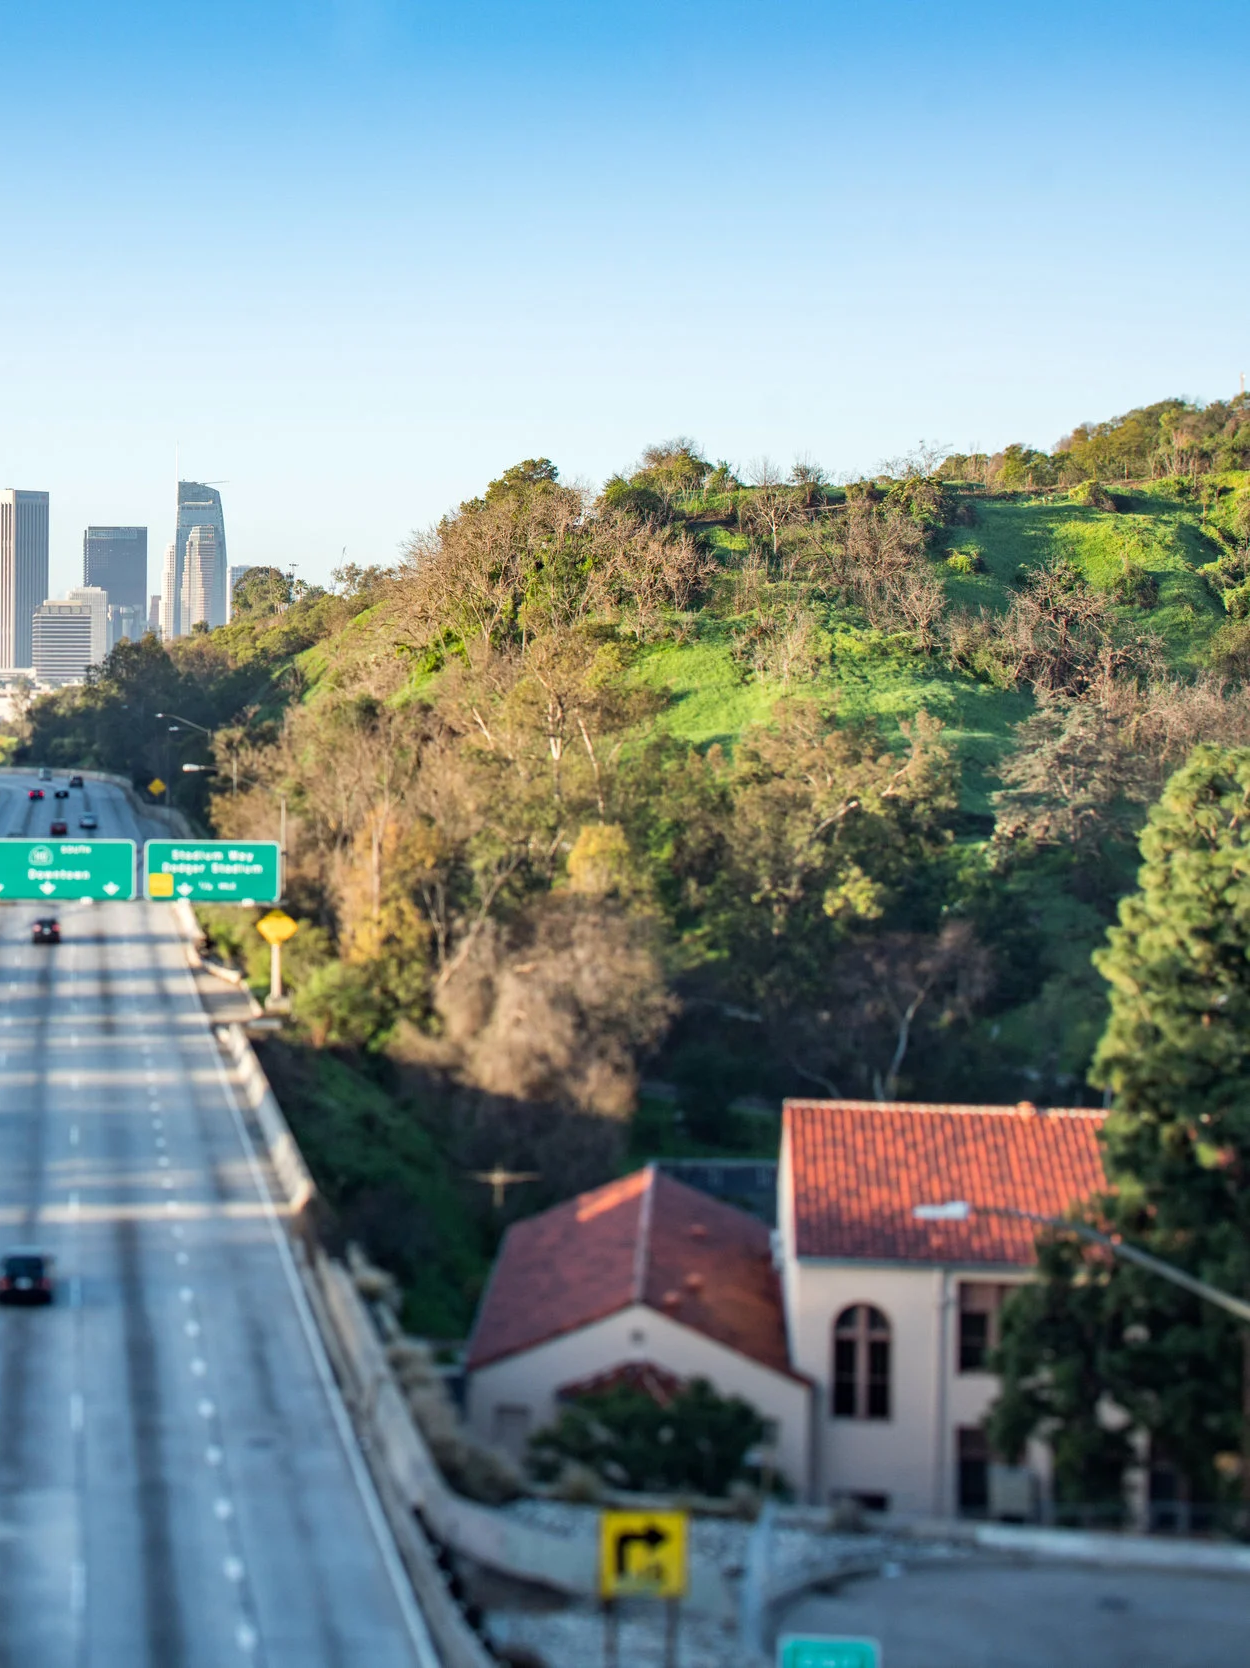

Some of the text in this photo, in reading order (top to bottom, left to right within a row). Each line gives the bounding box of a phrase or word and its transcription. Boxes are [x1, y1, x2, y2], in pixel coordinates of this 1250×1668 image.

[171, 849, 254, 863] Stadium Way
[27, 868, 91, 880] Downtown
[161, 861, 264, 876] Dodger Stadium
